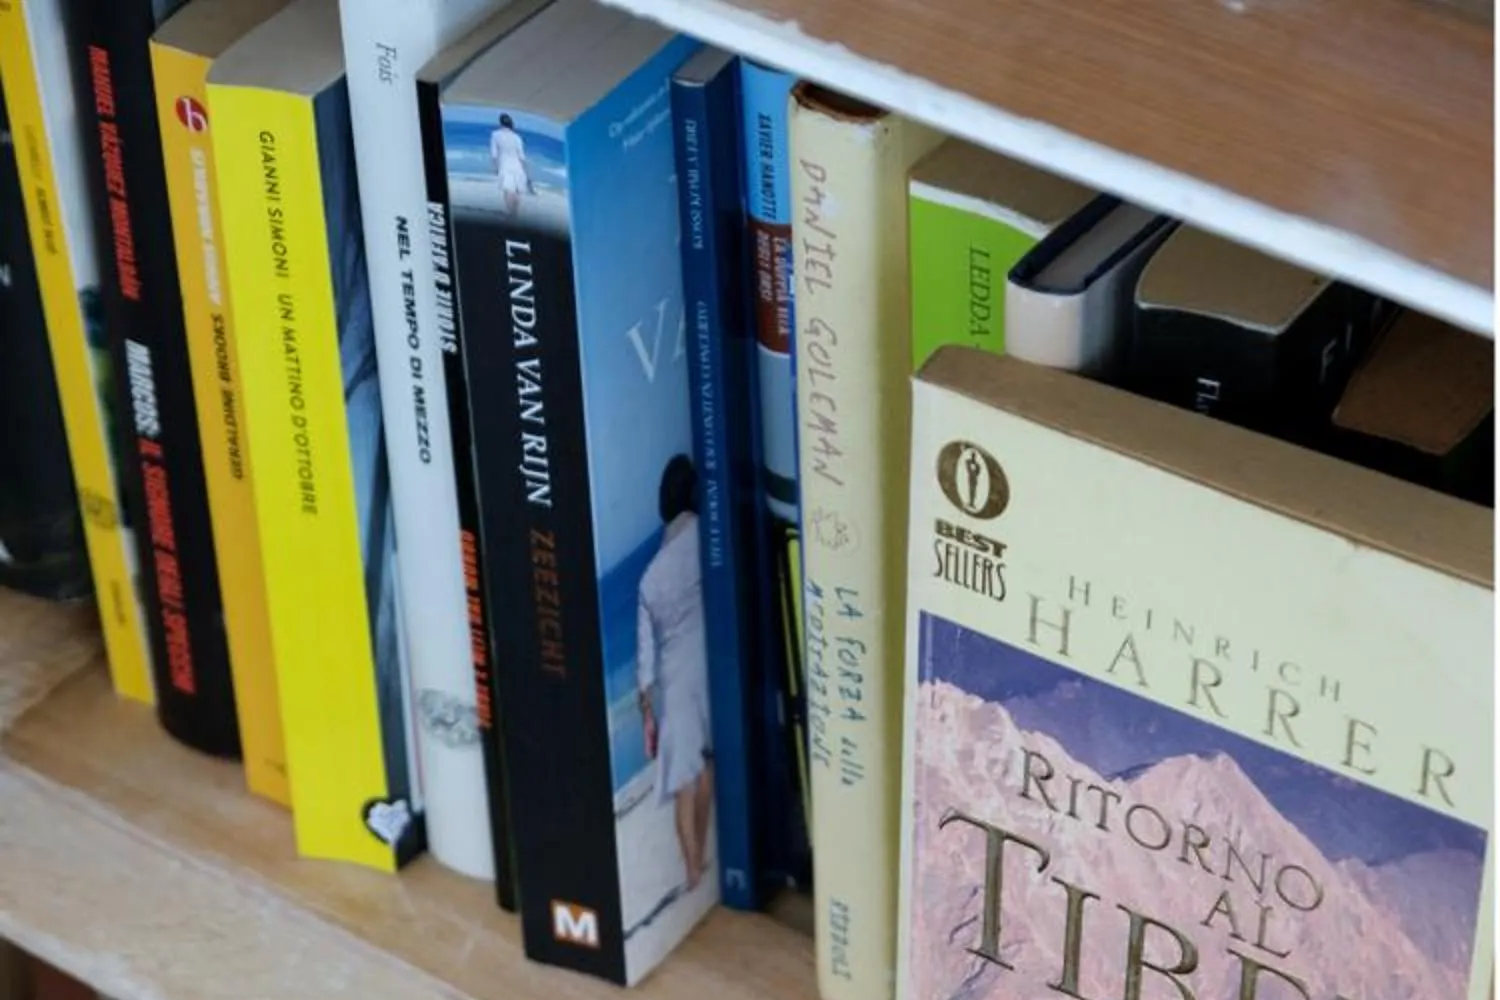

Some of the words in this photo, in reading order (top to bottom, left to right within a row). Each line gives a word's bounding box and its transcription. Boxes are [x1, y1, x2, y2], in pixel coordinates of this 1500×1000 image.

[89, 46, 116, 118] MANUEL
[376, 42, 398, 84] Fois
[259, 131, 281, 202] GIANNI
[759, 113, 776, 162] XAVIER
[267, 207, 289, 278] SIMONI
[397, 216, 411, 261] NEL
[801, 159, 837, 297] DANIEL
[278, 295, 293, 321] UN
[399, 269, 420, 350] TEMPO
[505, 240, 538, 350] LINDA
[969, 246, 992, 338] LEDDA
[211, 313, 233, 382] BROOKS
[281, 324, 305, 412] MATTINO
[411, 356, 424, 382] DI
[414, 386, 431, 465] MEZZO
[515, 358, 544, 424] VAN
[804, 317, 845, 486] GOLEMAN
[222, 388, 244, 481] GERALDINE
[293, 415, 318, 515] D'OTTOBRE
[520, 430, 552, 506] RIJN
[933, 540, 1007, 602] SELLERS
[935, 519, 1007, 556] BEST
[531, 529, 566, 678] ZEEZICHT
[835, 585, 862, 622] LA
[1067, 577, 1340, 700] HEINRICH
[837, 638, 866, 723] FORZA
[1026, 594, 1455, 805] HARRER
[1021, 747, 1323, 912] RITORNO
[1200, 892, 1290, 958] AL
